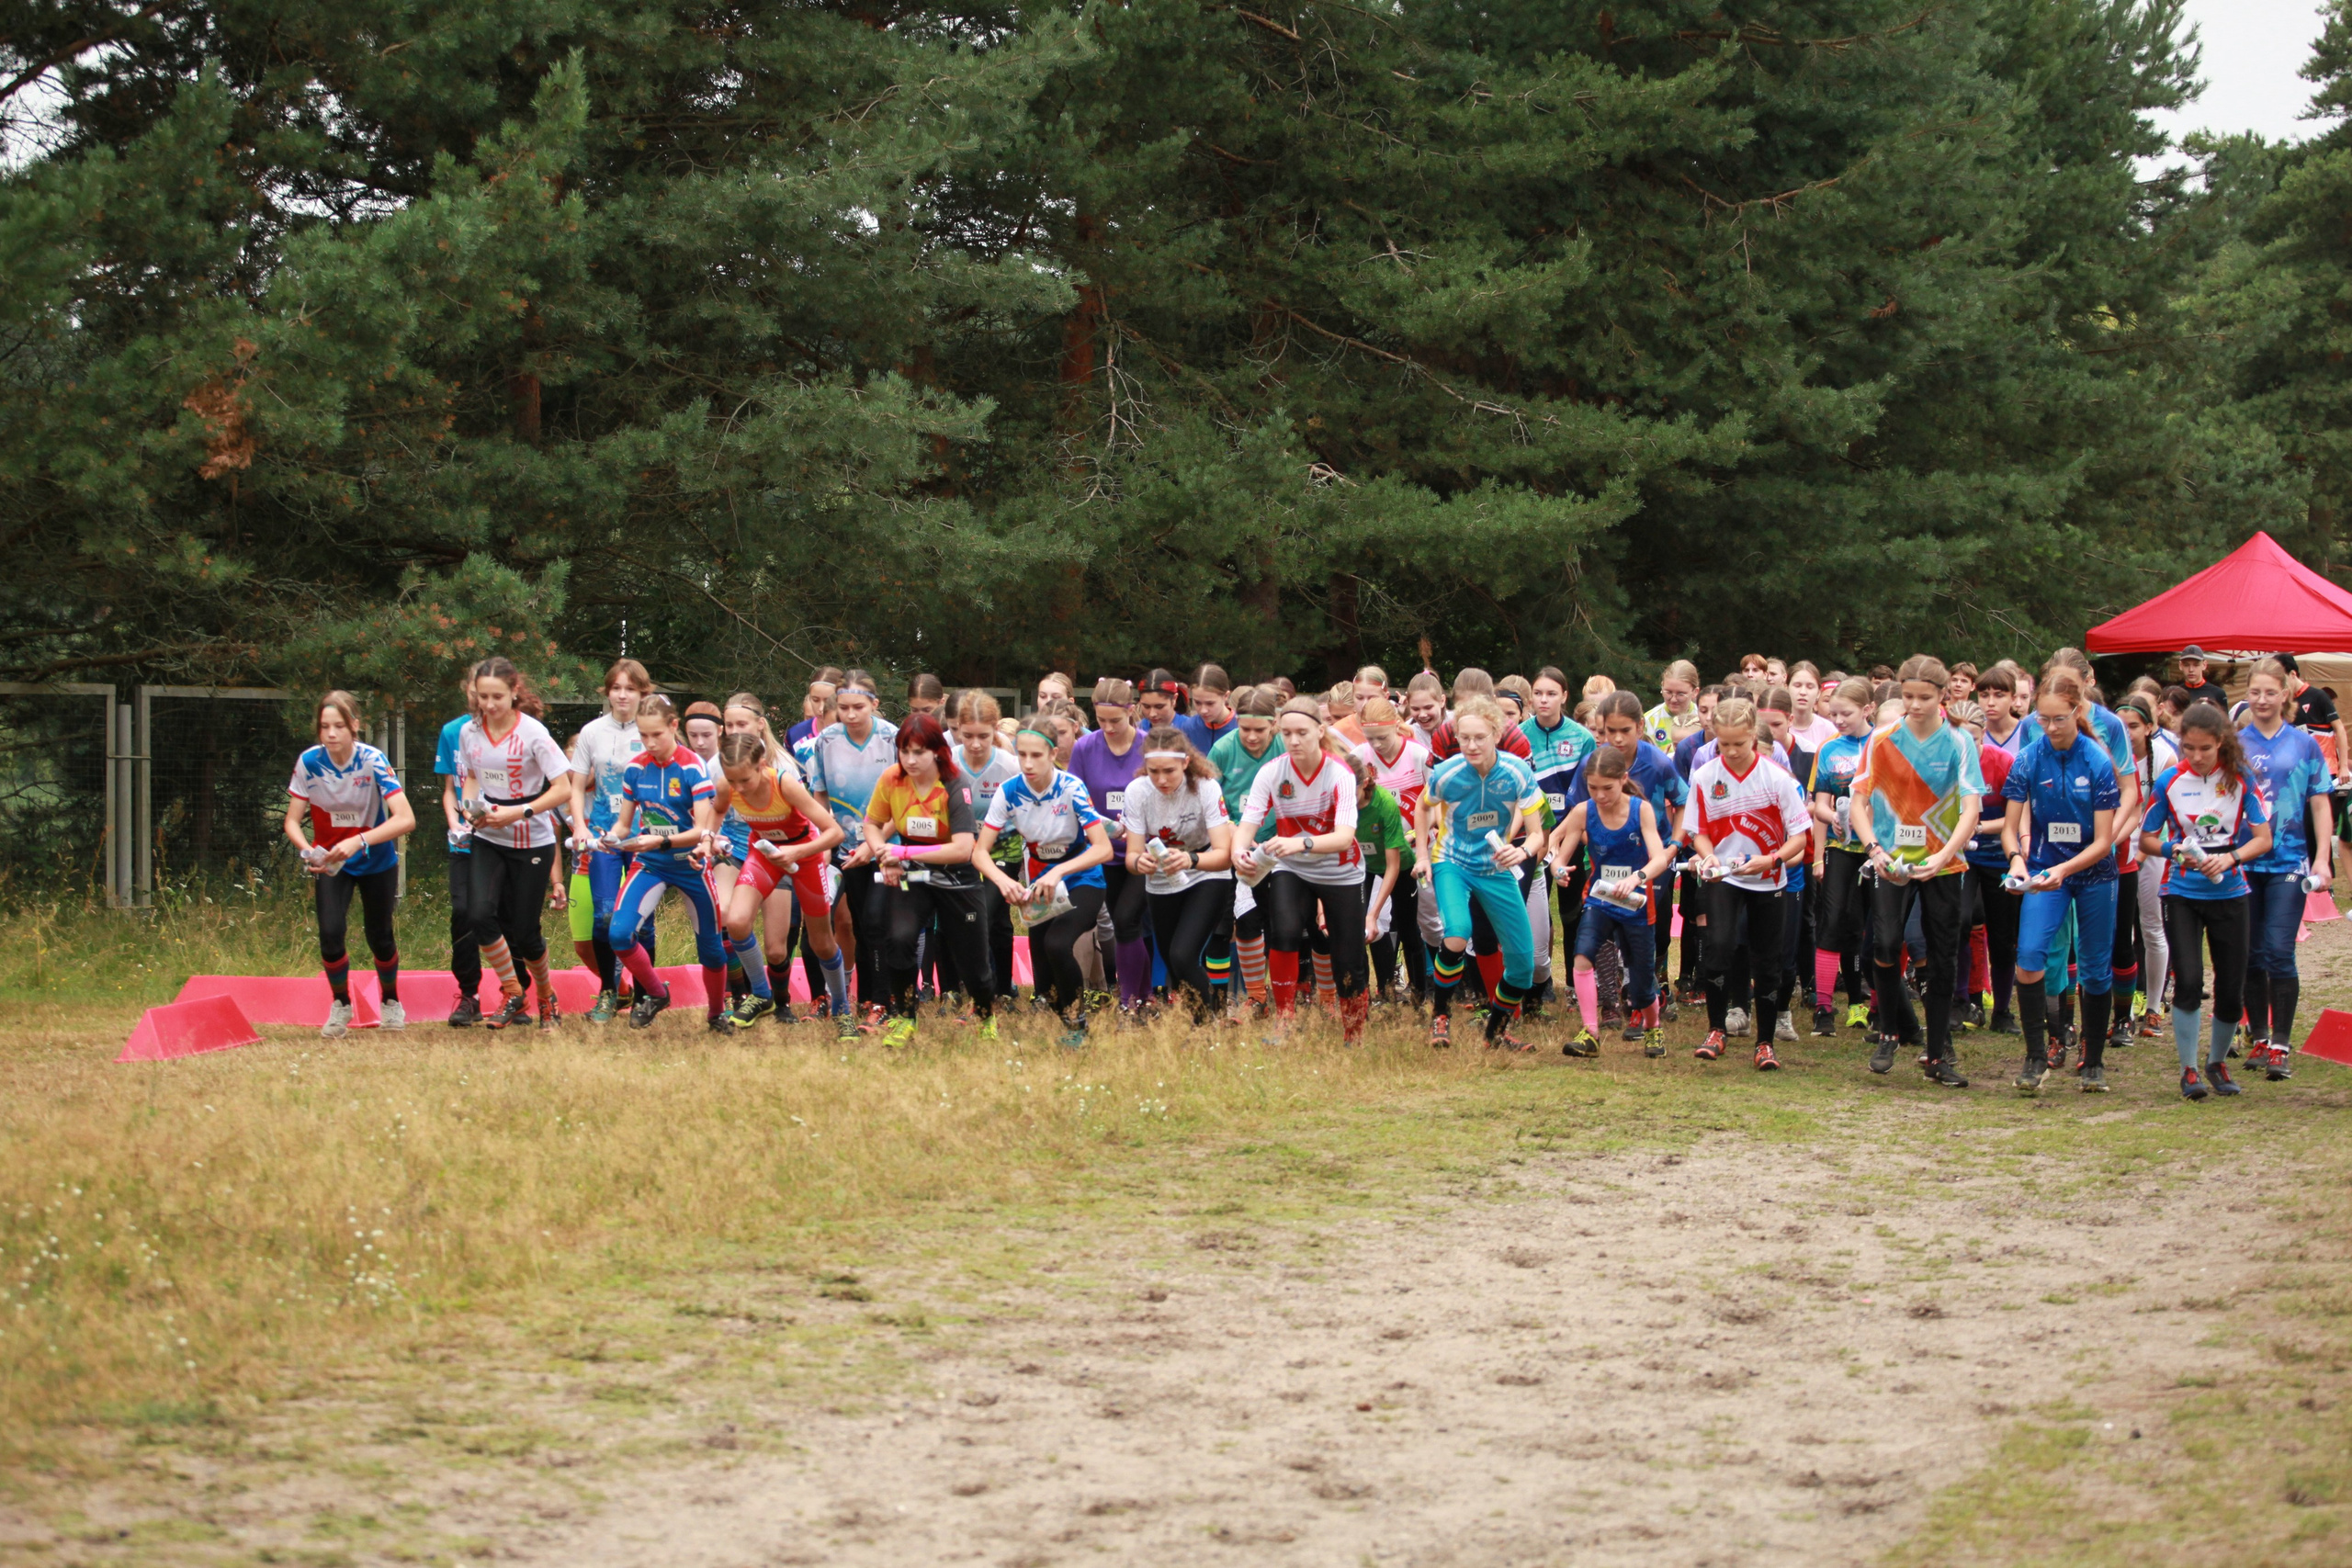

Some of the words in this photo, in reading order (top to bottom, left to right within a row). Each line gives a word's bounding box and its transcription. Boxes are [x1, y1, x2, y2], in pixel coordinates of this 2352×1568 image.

[484, 771, 504, 782] 2002
[1111, 795, 1125, 803] 202
[1547, 795, 1562, 804] 054
[335, 813, 356, 821] 2001
[1472, 814, 1495, 824] 2009
[911, 820, 933, 829] 2005
[1739, 816, 1759, 831] Run
[1758, 829, 1776, 847] and
[1899, 829, 1922, 839] 2012
[2053, 826, 2076, 836] 2013
[1605, 868, 1627, 878] 2010
